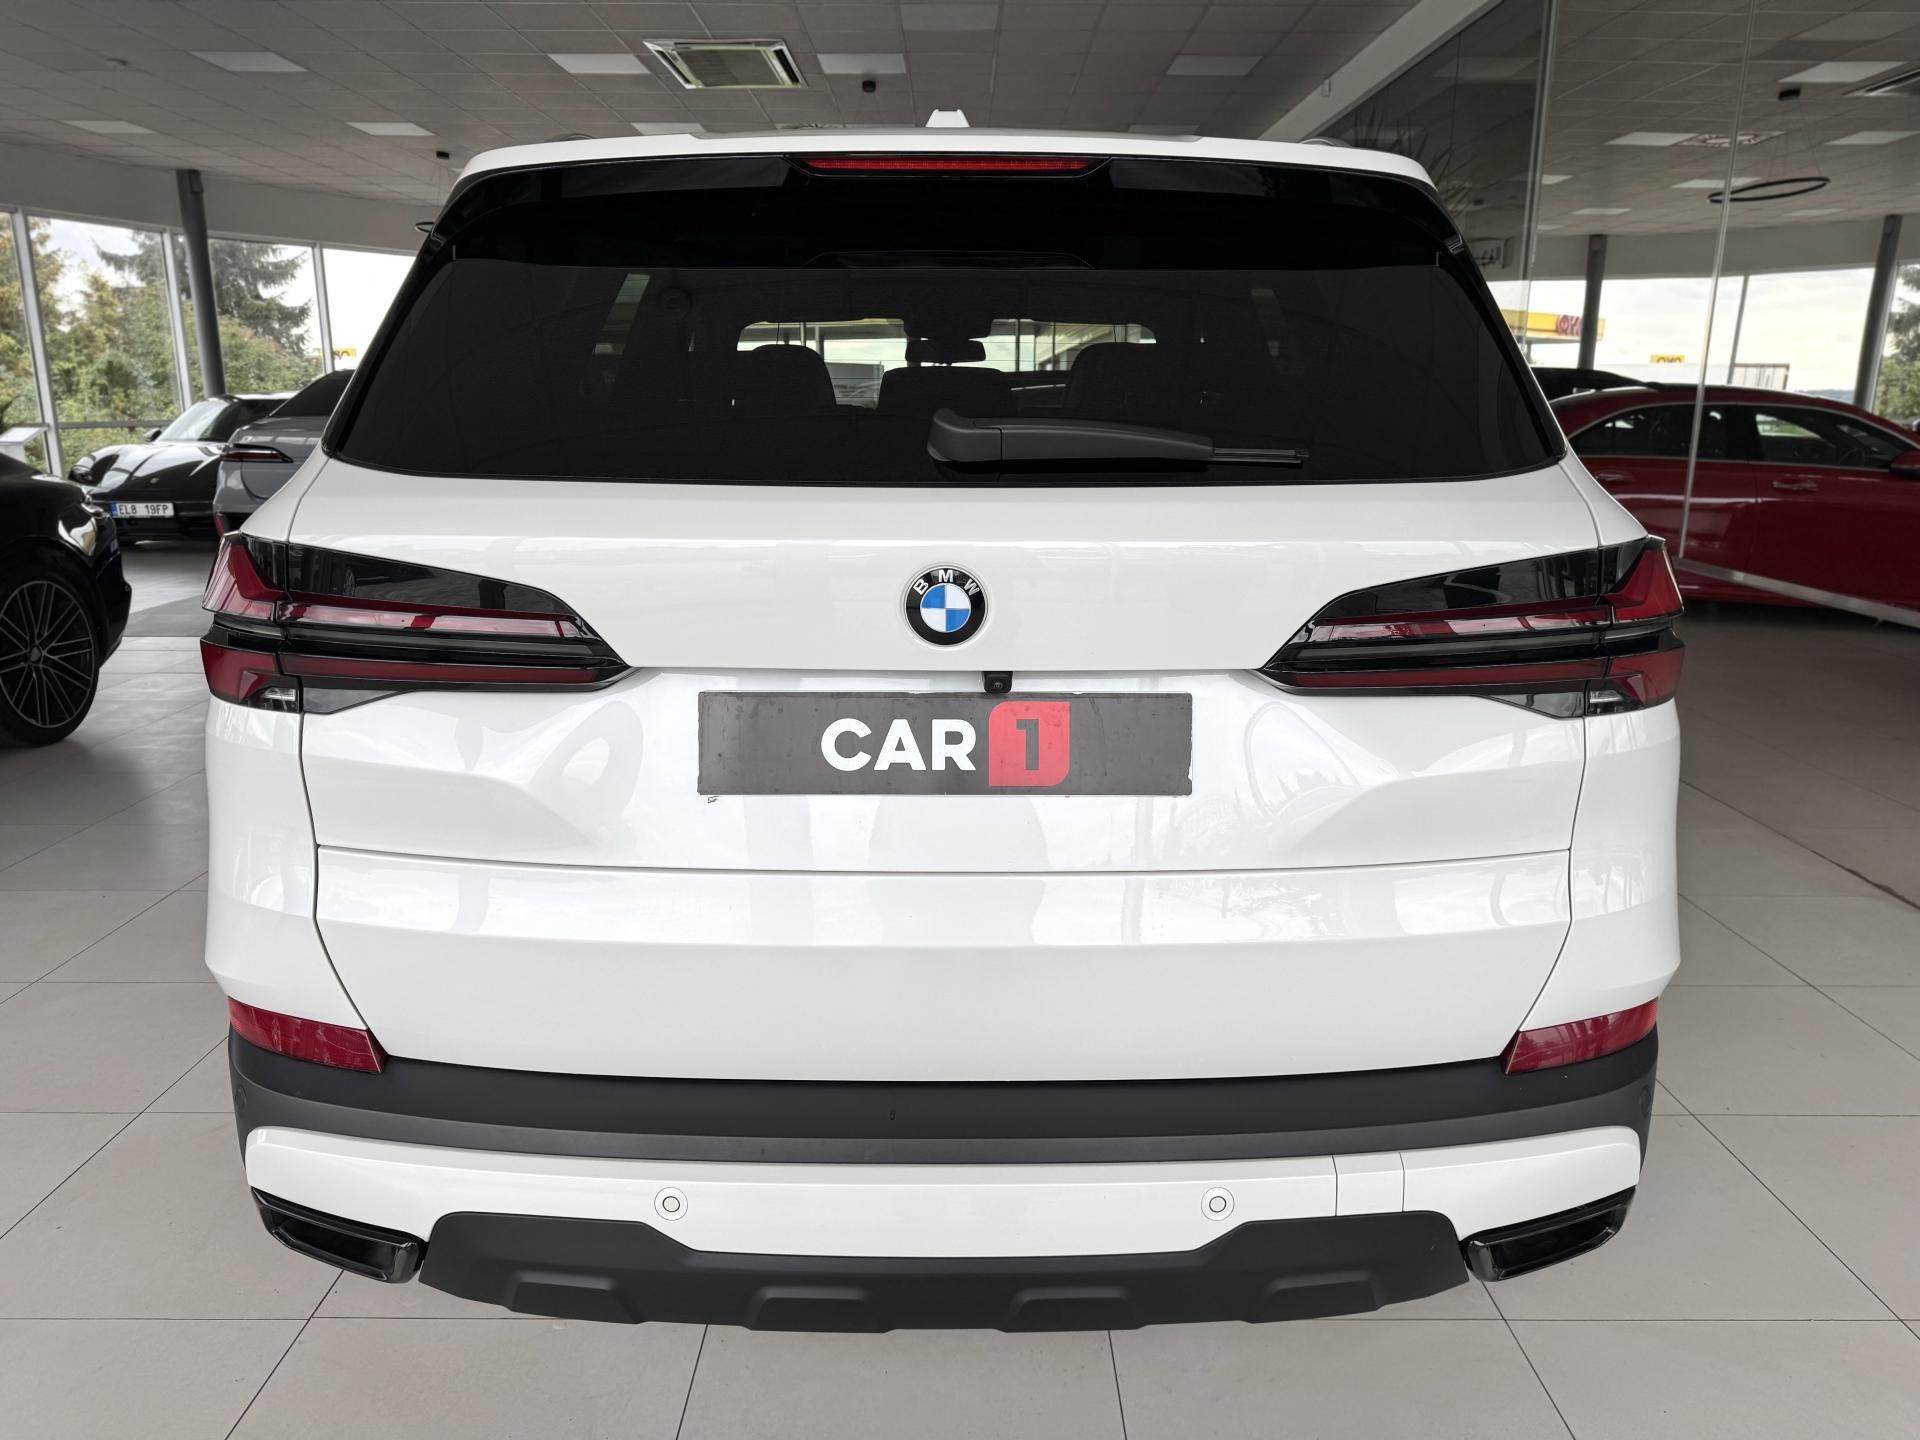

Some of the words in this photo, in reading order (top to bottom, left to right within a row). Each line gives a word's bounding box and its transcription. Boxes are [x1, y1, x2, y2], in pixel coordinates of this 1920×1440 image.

[119, 504, 137, 515] EL8
[144, 504, 168, 515] 19FP
[913, 569, 981, 596] BMW
[821, 718, 977, 772] CAR
[1016, 719, 1039, 771] 1
